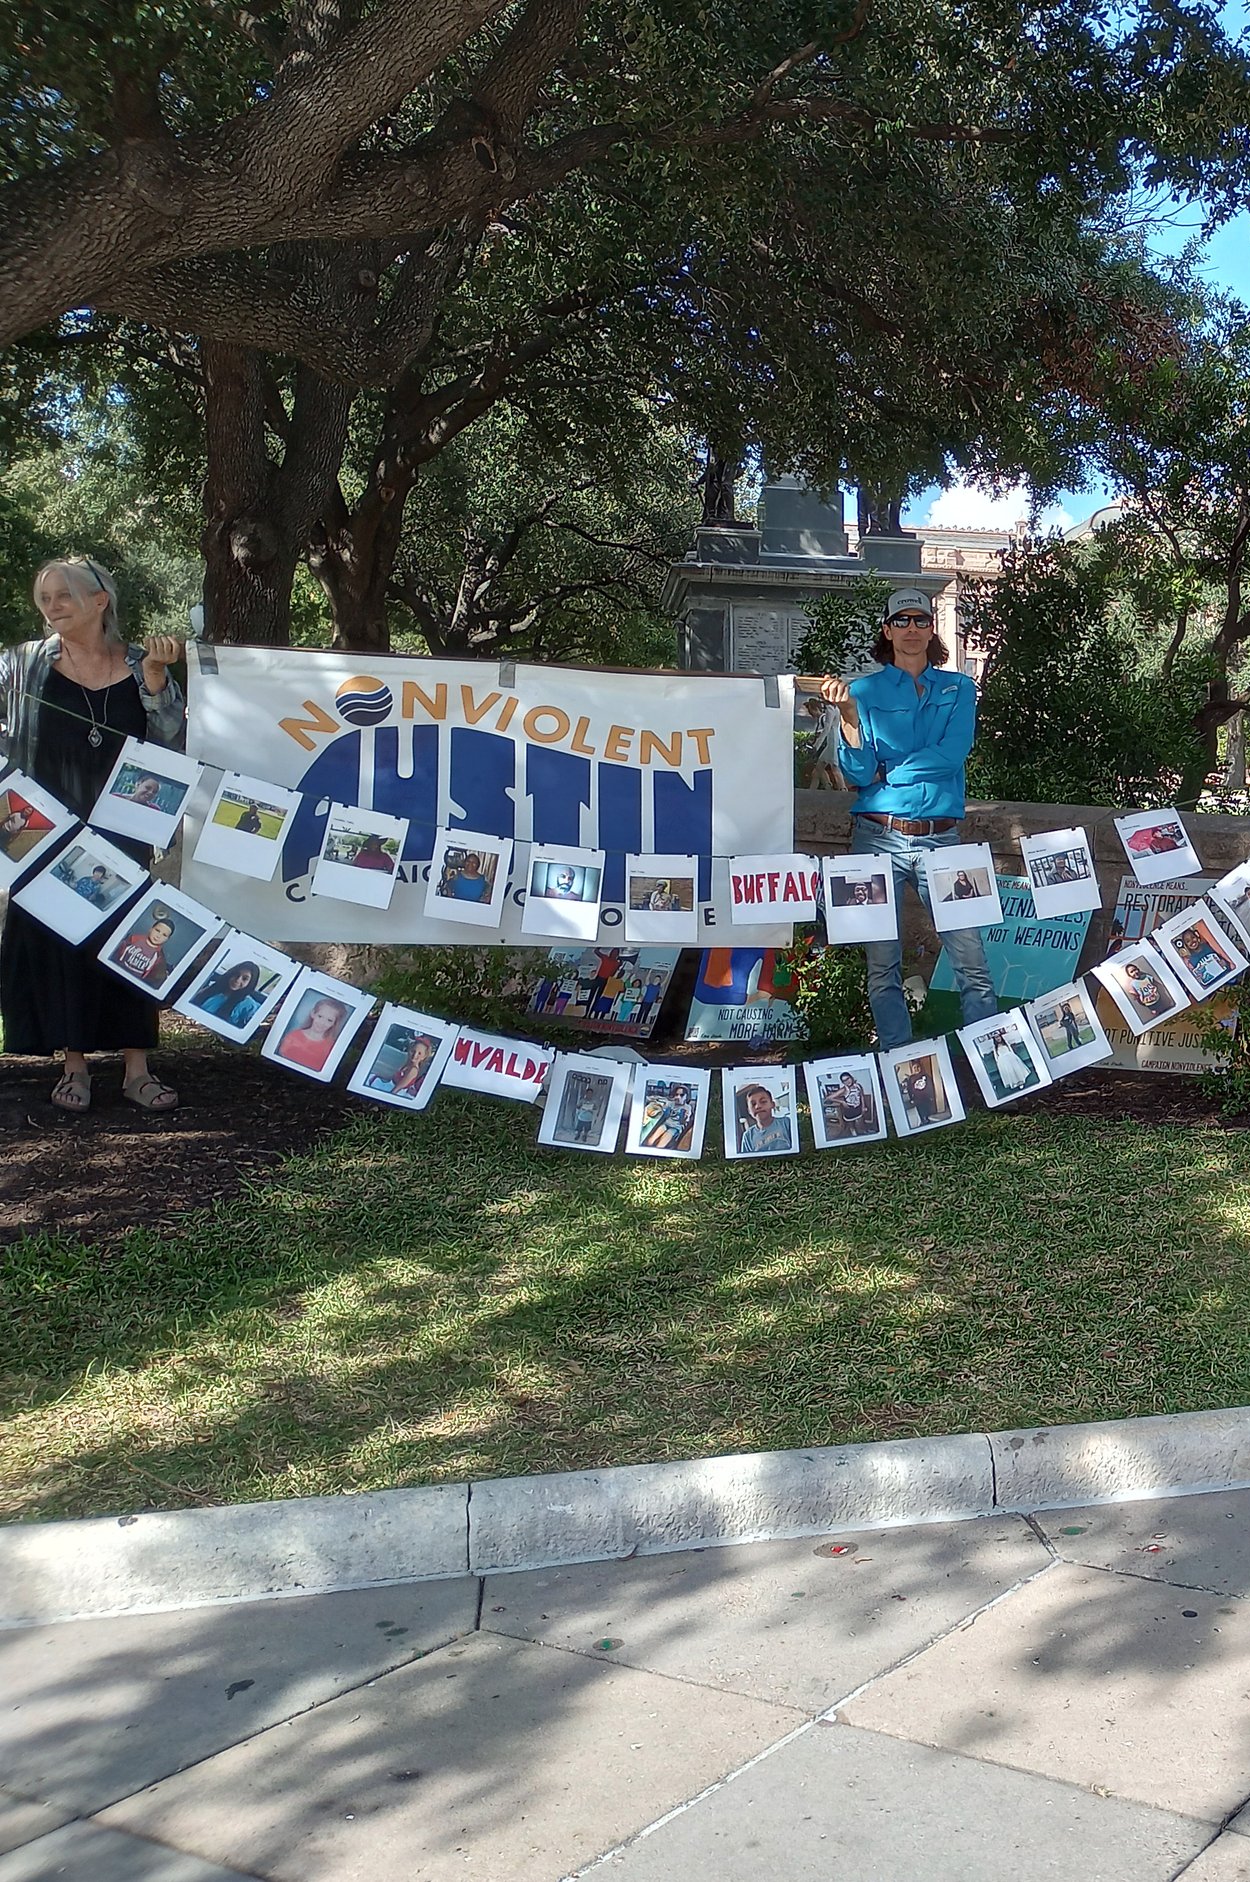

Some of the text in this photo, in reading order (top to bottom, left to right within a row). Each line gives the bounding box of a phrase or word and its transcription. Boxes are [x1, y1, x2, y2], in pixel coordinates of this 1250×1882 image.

[987, 926, 1081, 951] NOT WEAPONS
[718, 1008, 774, 1021] NOT CAUSING
[728, 1022, 760, 1039] MORE
[1104, 1028, 1119, 1043] OT
[454, 1036, 550, 1084] UVALDE
[1141, 1059, 1170, 1071] CAMPAIGN
